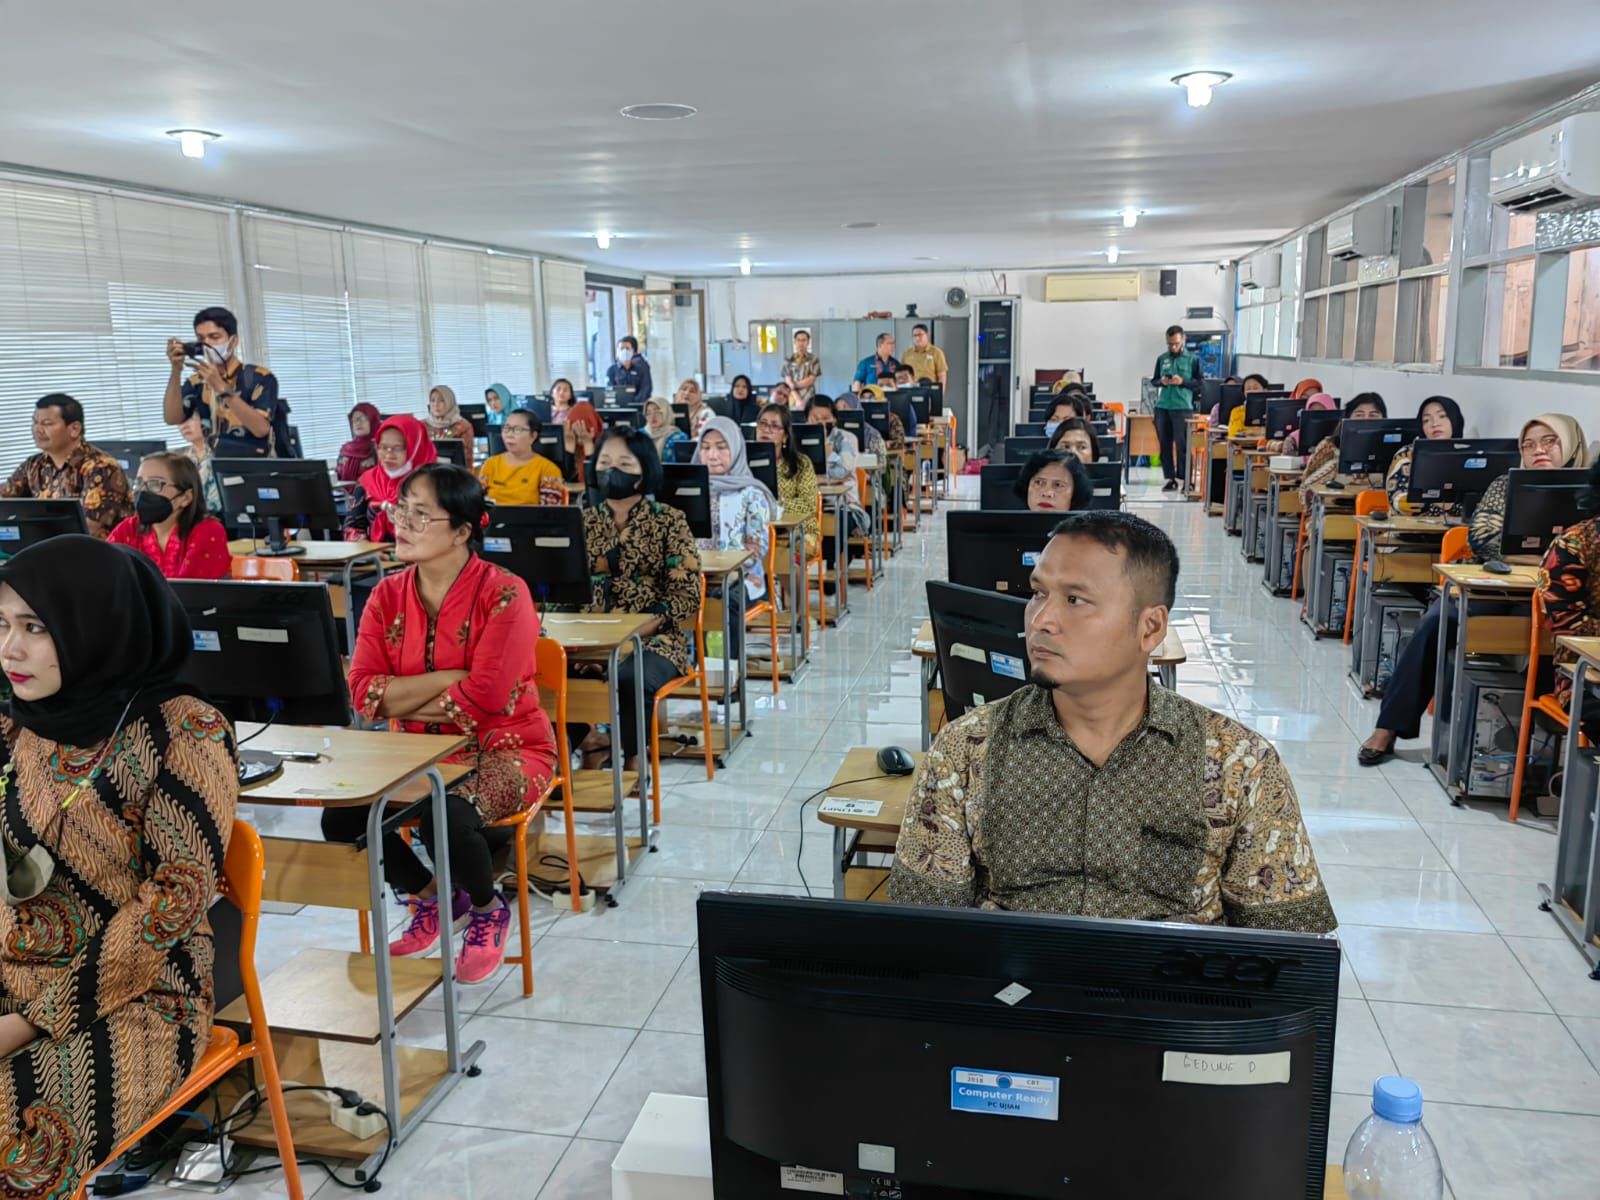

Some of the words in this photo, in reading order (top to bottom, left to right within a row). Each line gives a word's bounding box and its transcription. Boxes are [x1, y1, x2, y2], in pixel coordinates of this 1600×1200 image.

[958, 1087, 1012, 1100] Computer
[1016, 1093, 1050, 1105] Ready
[987, 1101, 998, 1109] PC
[999, 1101, 1020, 1111] UJIAN
